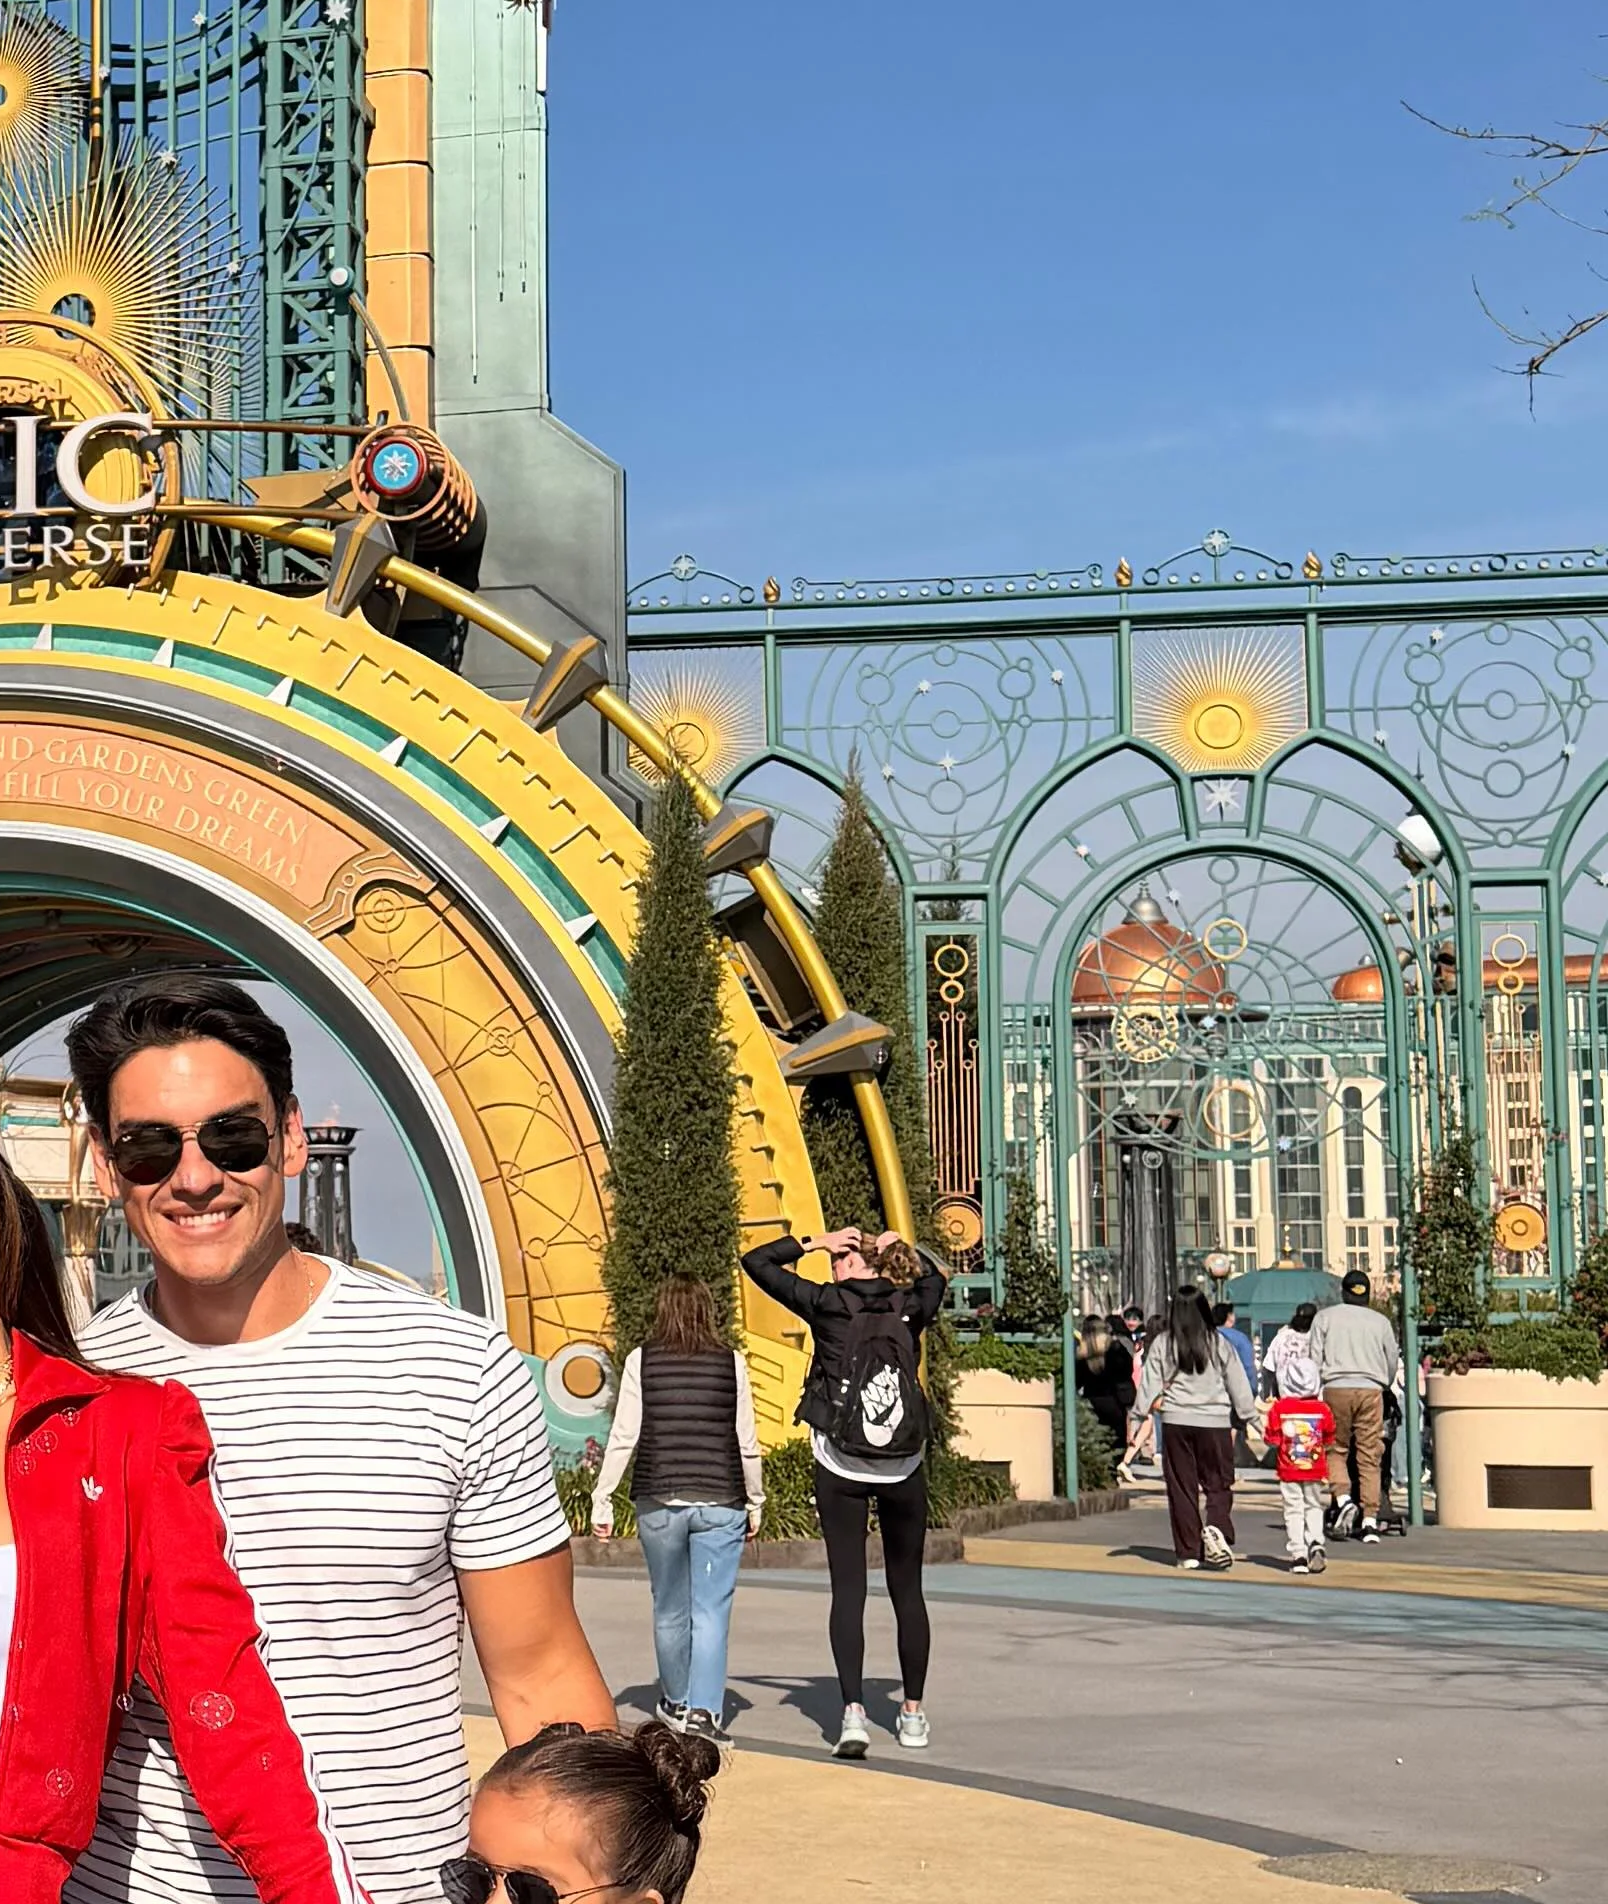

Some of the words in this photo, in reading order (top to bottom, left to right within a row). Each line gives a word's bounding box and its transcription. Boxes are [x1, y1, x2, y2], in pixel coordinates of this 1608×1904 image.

[3, 771, 62, 801] FILL
[76, 777, 166, 822] YOUR
[173, 806, 304, 888] DREAMS
[43, 738, 196, 794] GARDENS
[203, 778, 308, 846] GREEN
